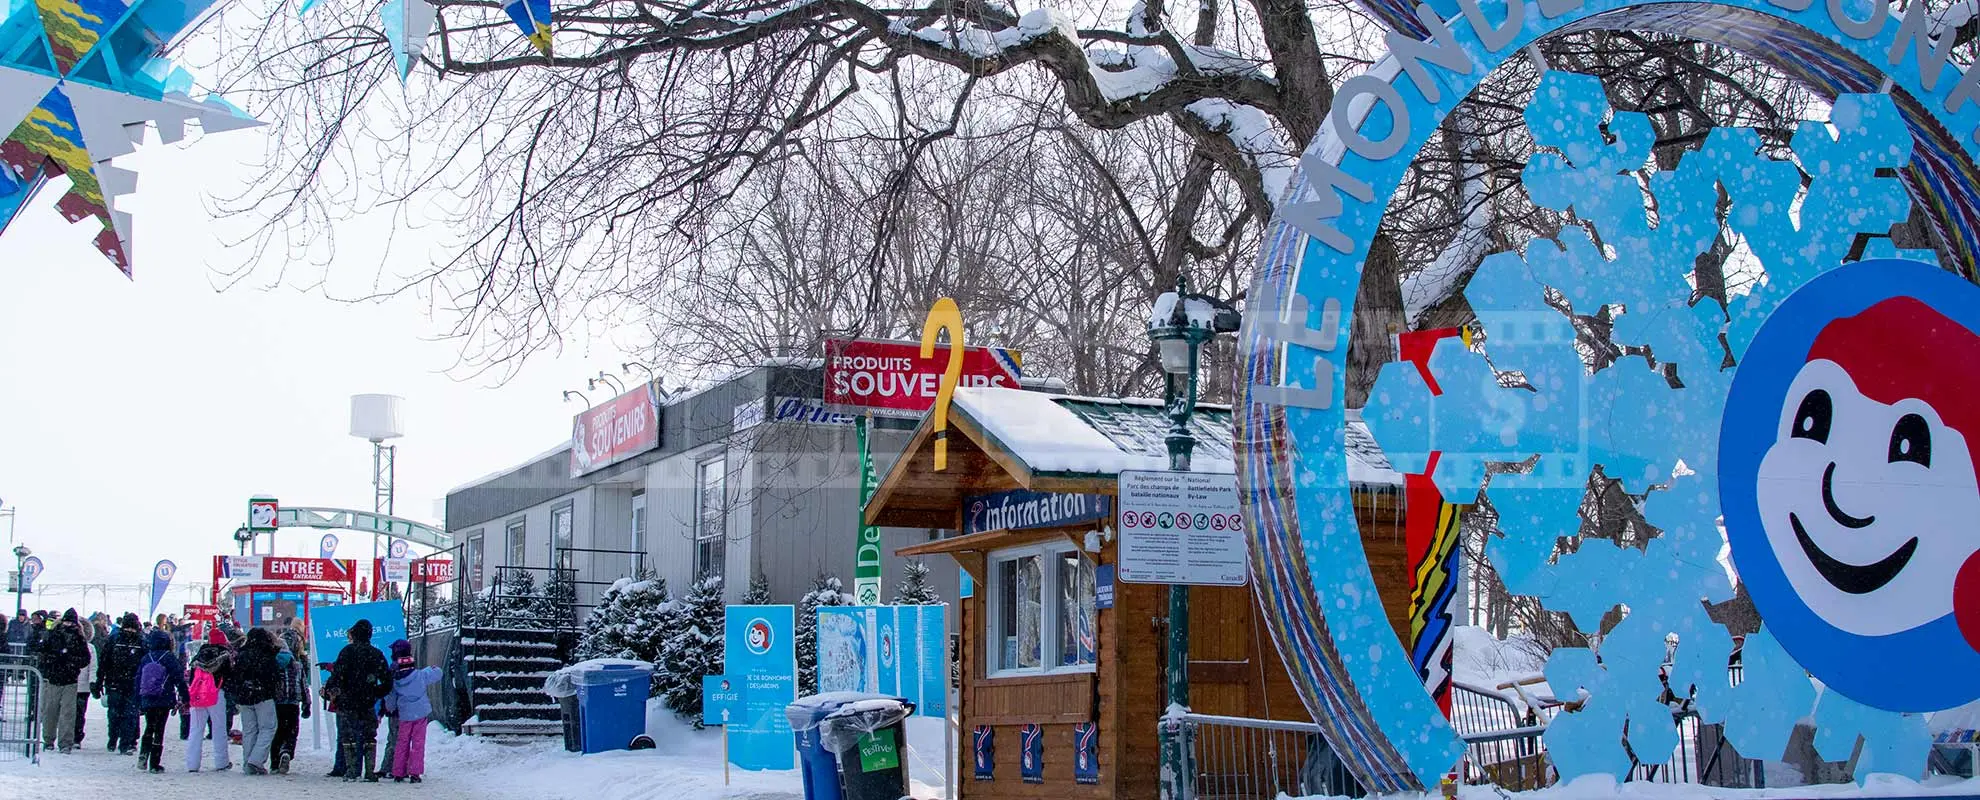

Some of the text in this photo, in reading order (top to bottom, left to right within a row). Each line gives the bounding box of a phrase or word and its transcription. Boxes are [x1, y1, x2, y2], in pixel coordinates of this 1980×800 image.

[1280, 0, 1585, 255] MOND
[1252, 279, 1341, 410] LE
[833, 355, 912, 371] PRODUITS
[833, 370, 1006, 397] SOUVEIRS
[592, 404, 617, 432] PRODUITS
[592, 402, 646, 460] SOUVENIRS
[1126, 482, 1139, 490] Parc
[1150, 483, 1172, 492] champs
[1187, 476, 1211, 484] National
[1152, 491, 1180, 499] nationaux
[1187, 485, 1218, 493] Battlefields
[986, 492, 1086, 531] information
[271, 560, 324, 575] ENTRÉE
[712, 693, 739, 701] EFFIGIE
